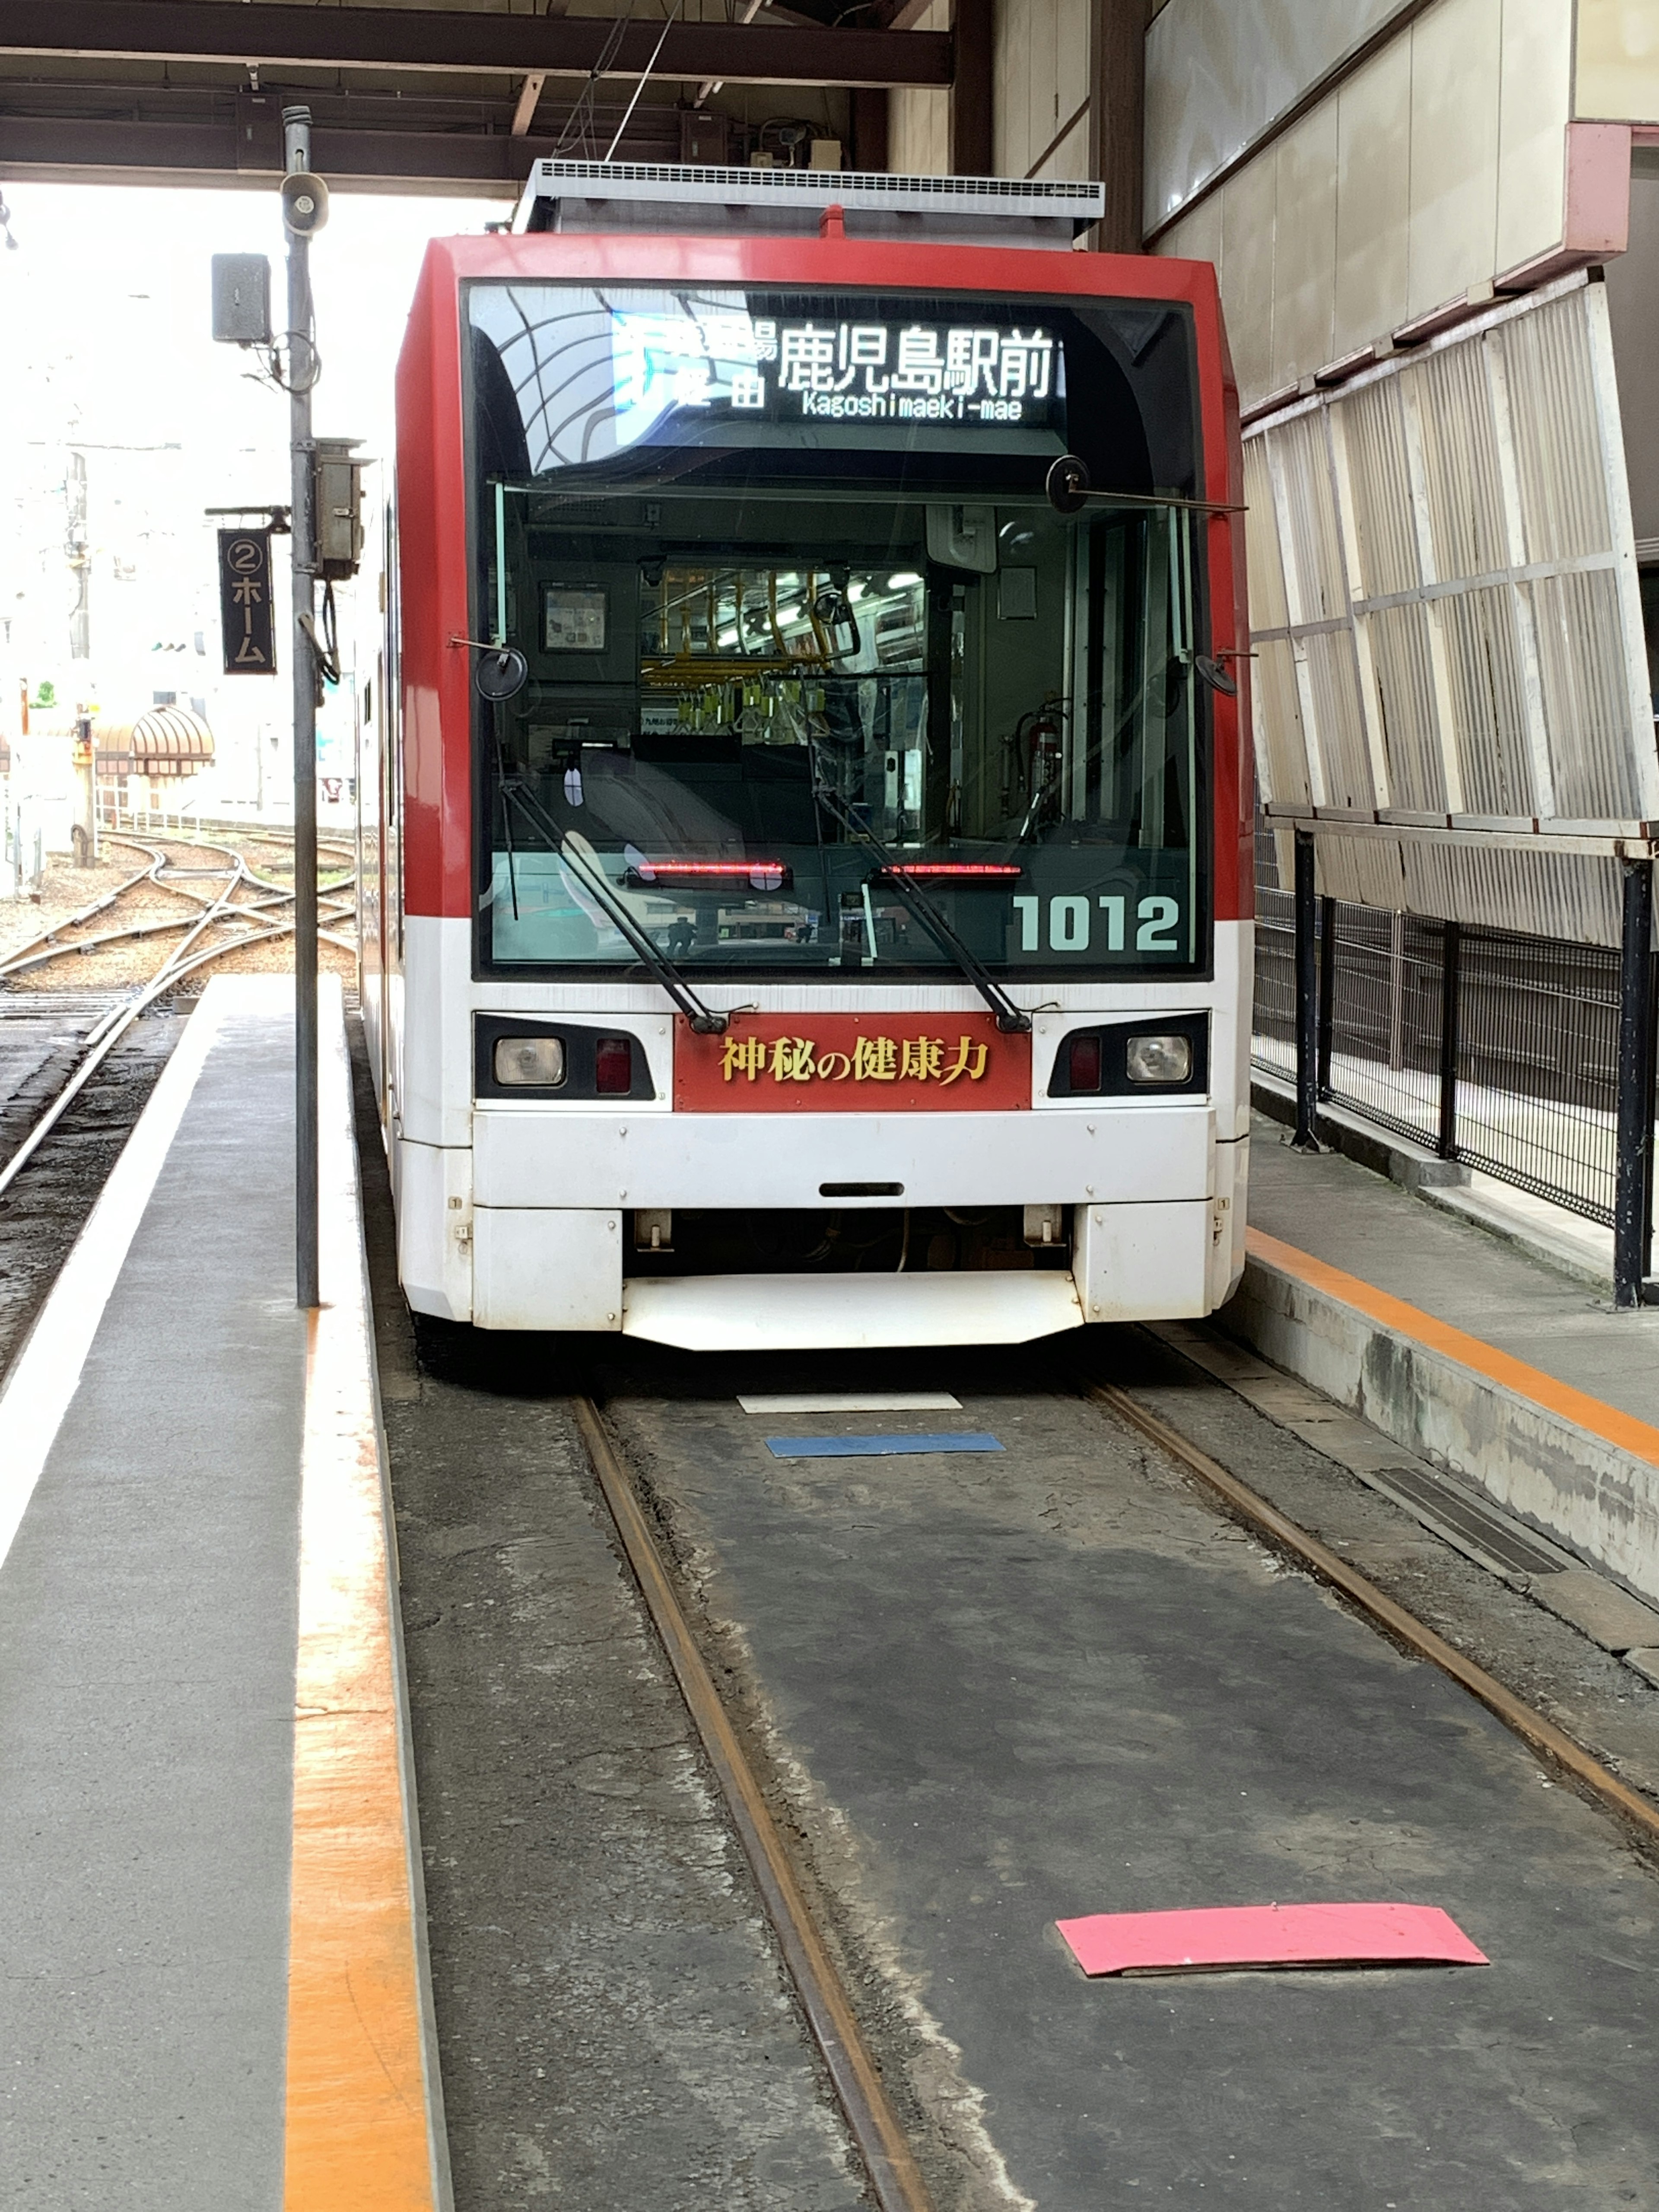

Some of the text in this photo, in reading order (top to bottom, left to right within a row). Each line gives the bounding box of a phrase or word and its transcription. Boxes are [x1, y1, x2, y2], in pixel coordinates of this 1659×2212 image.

[779, 322, 1053, 398] 鹿児島駅前
[802, 390, 1023, 418] Kagoshimaeki-mae
[1013, 896, 1179, 951] 1012
[718, 1036, 990, 1087] 神秘の健康力
